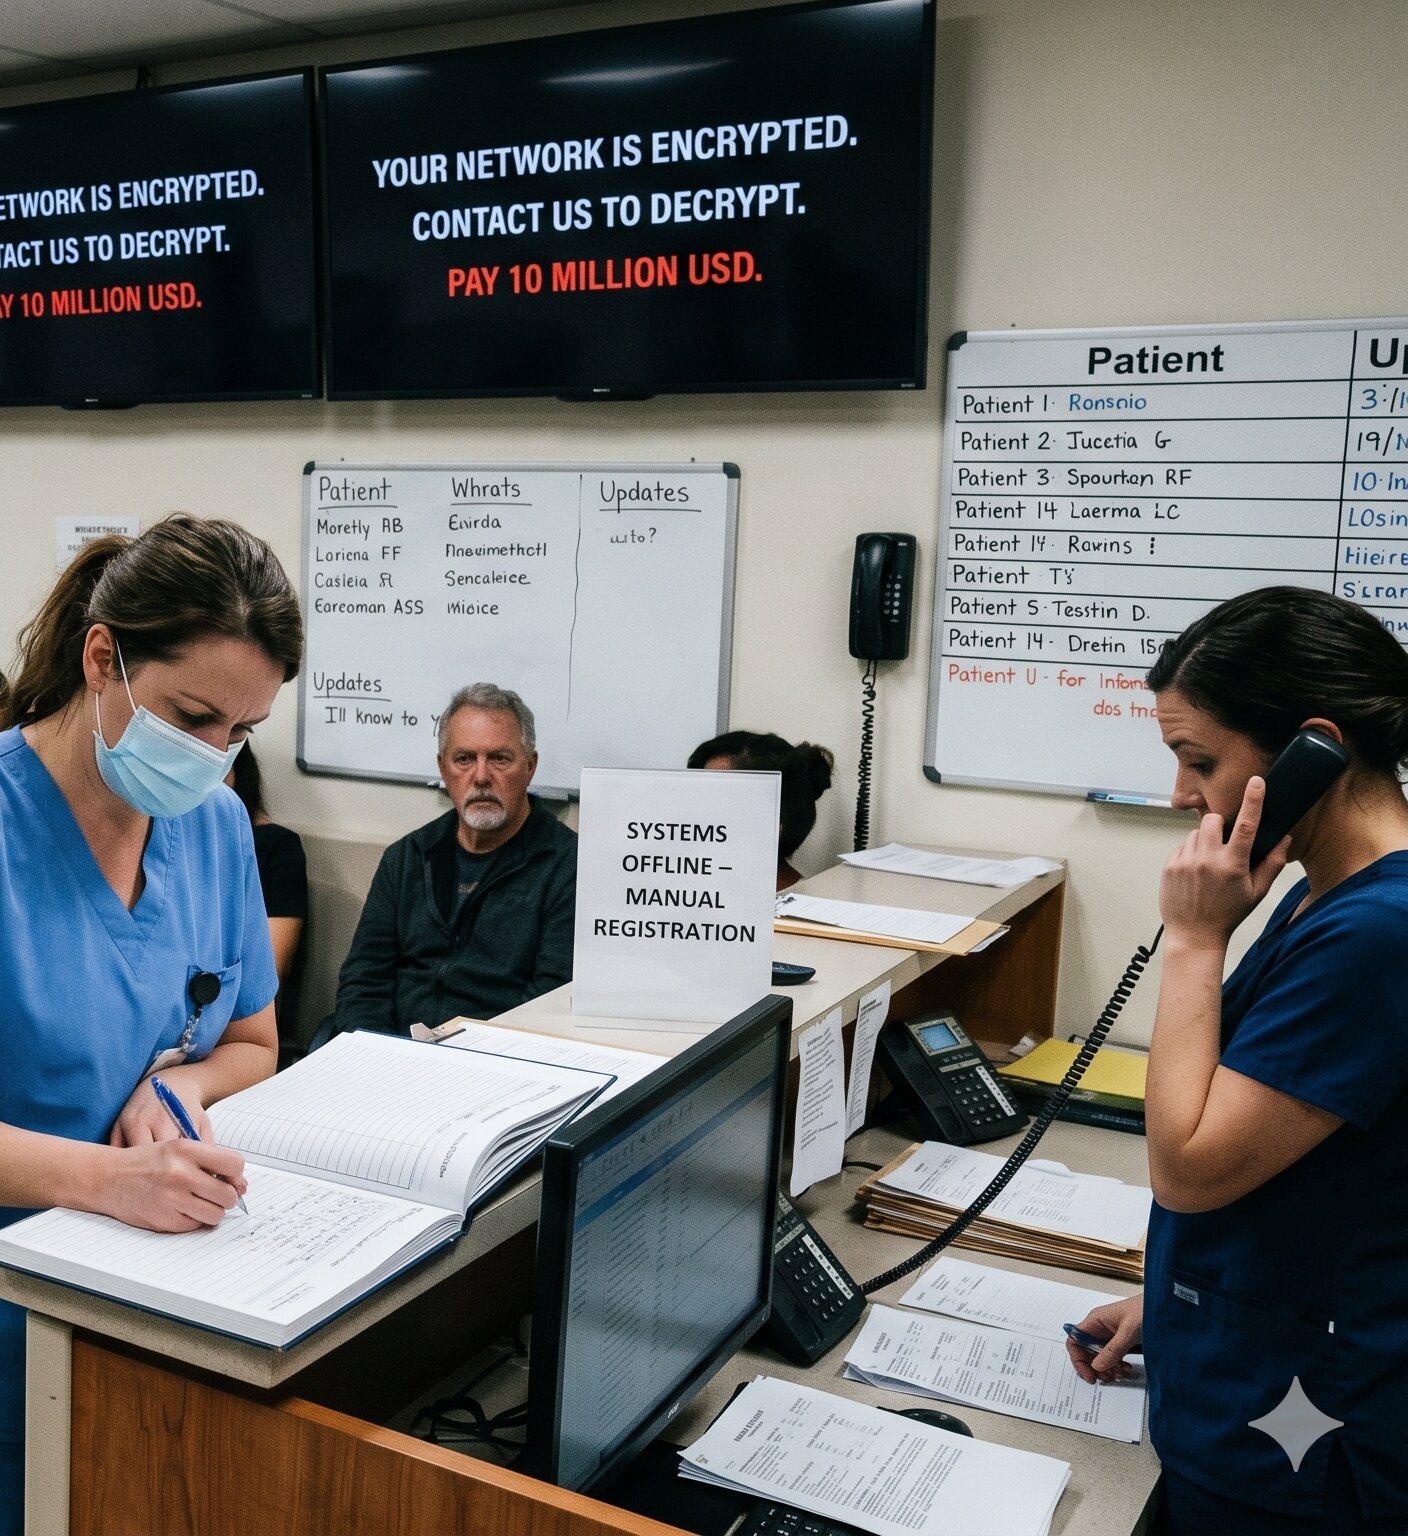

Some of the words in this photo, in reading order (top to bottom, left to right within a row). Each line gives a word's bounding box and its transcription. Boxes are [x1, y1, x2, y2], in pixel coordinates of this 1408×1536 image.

[373, 154, 447, 188] YOUR
[456, 139, 604, 180] NETWORK
[613, 135, 641, 167] IS
[652, 115, 857, 163] ENCRYPTED.
[91, 184, 112, 212] IS
[119, 170, 264, 209] ENCRYPTED.
[413, 202, 544, 241] CONTACT
[553, 199, 592, 231] US
[601, 195, 640, 227] TO
[651, 182, 806, 224] DECRYPT.
[50, 238, 79, 265] US
[85, 234, 113, 262] TO
[120, 225, 230, 259] DECRYPT.
[449, 267, 499, 297] PAY
[509, 264, 542, 294] 10
[552, 256, 678, 292] MILLION
[689, 252, 762, 286] USD.
[21, 292, 44, 317] 10
[51, 286, 141, 316] MILLION
[148, 282, 202, 311] USD.
[1088, 345, 1224, 375] Patient
[963, 395, 1033, 414] Patient
[961, 432, 1029, 450] Patient
[1155, 431, 1171, 448] G
[958, 468, 1027, 486] Patient
[1165, 469, 1192, 485] RF
[320, 477, 392, 501] Patient
[452, 477, 520, 497] Whrats
[601, 480, 689, 513] Updates
[956, 500, 1025, 518] Patient
[1038, 502, 1057, 519] 14
[1071, 502, 1141, 518] Laerma
[1155, 503, 1180, 519] LC
[318, 519, 370, 540] Moretly
[383, 518, 403, 532] AB
[317, 546, 368, 562] Loriena
[382, 546, 401, 560] FF
[955, 534, 1020, 552] Patient
[954, 565, 1029, 584] Patient
[394, 599, 423, 614] ASS
[951, 597, 1016, 615] Patient
[1052, 600, 1118, 619] Tesstin
[1133, 605, 1150, 621] D.
[950, 629, 1016, 647] Patient
[1027, 632, 1042, 650] 14
[1069, 635, 1125, 653] Dretin
[314, 672, 382, 698] Updates
[949, 664, 1015, 684] Patient
[1027, 668, 1036, 685] U
[1057, 669, 1086, 687] for
[357, 708, 392, 724] know
[402, 710, 418, 725] to
[1094, 699, 1121, 716] dos
[627, 822, 727, 842] SYSTEMS
[623, 855, 712, 875] OFFLINE
[626, 888, 725, 908] MANUAL
[594, 919, 755, 942] REGISTRATION
